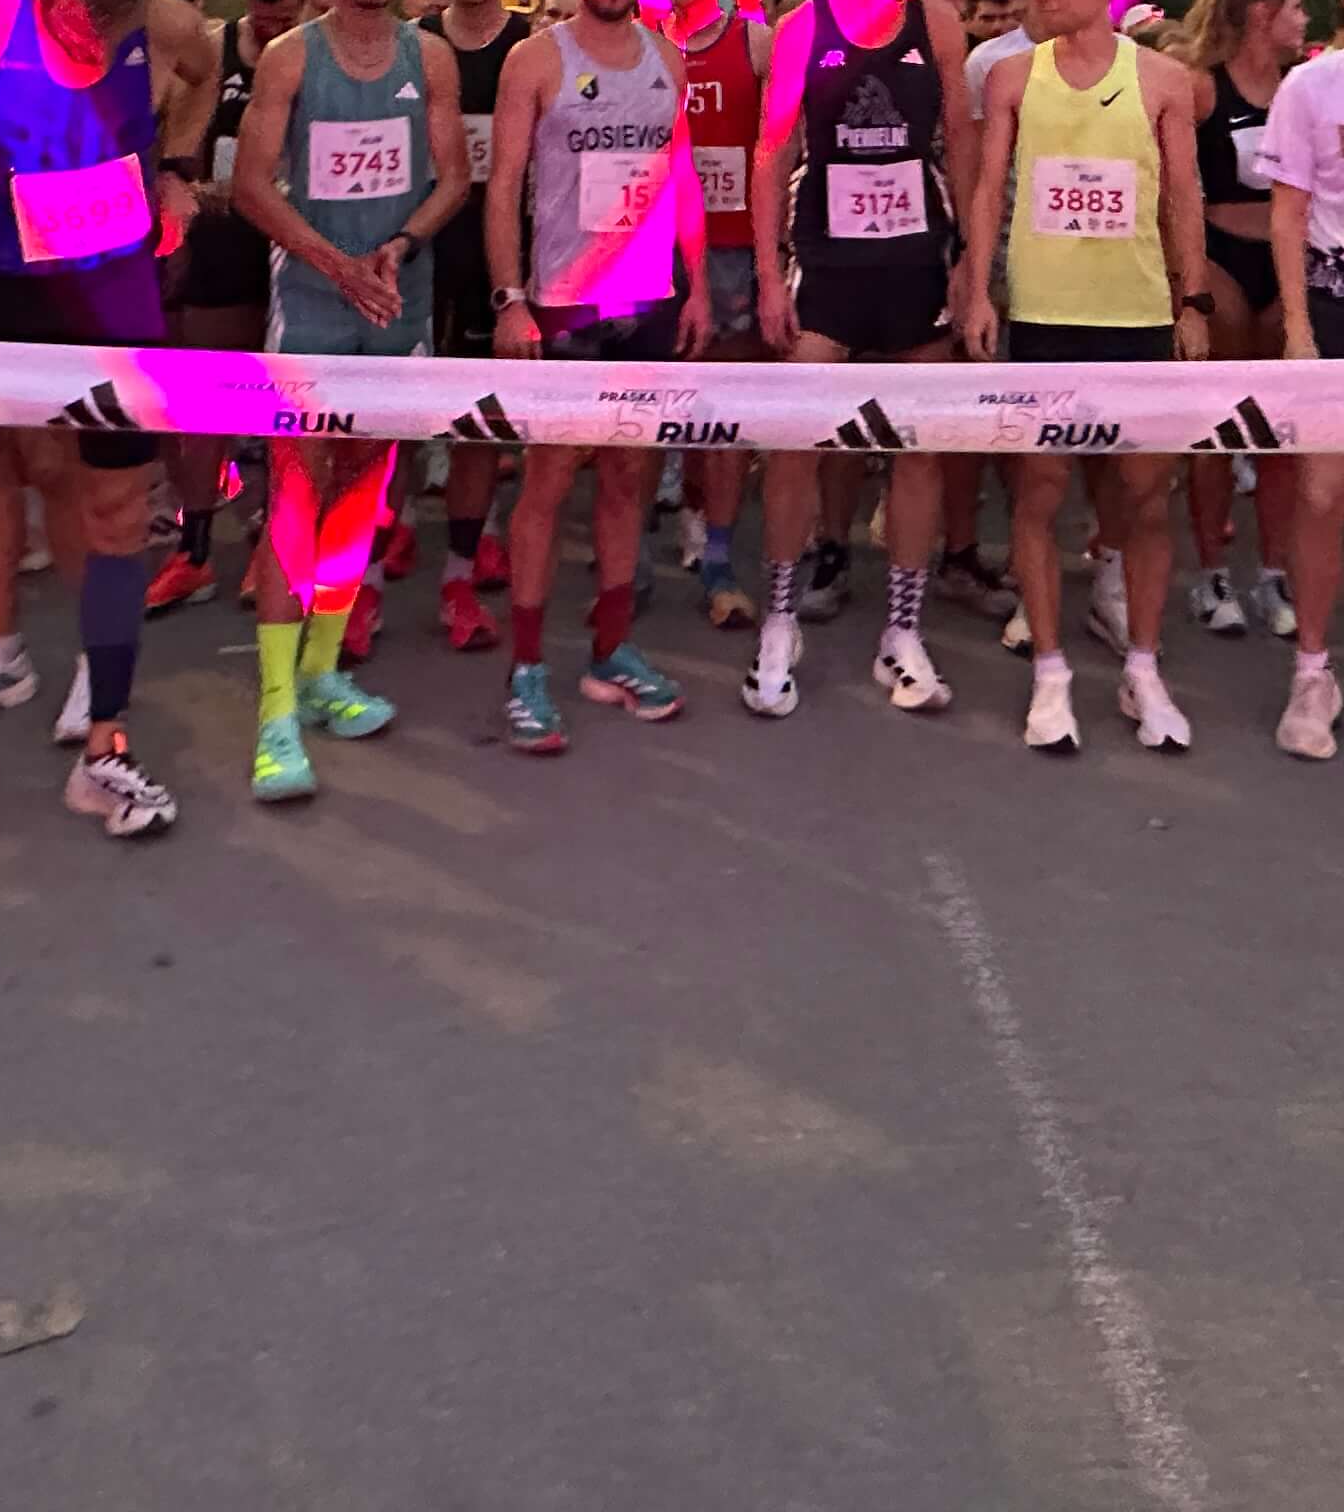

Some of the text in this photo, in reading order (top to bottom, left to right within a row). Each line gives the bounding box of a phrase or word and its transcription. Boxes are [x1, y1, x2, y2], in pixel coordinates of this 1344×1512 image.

[330, 148, 400, 176] 3743
[622, 185, 650, 210] 15
[849, 190, 911, 215] 3174
[1048, 188, 1123, 213] 3883
[598, 391, 657, 402] PRASKA
[272, 410, 355, 433] RUN
[656, 421, 740, 444] RUN
[1036, 423, 1120, 446] RUN
